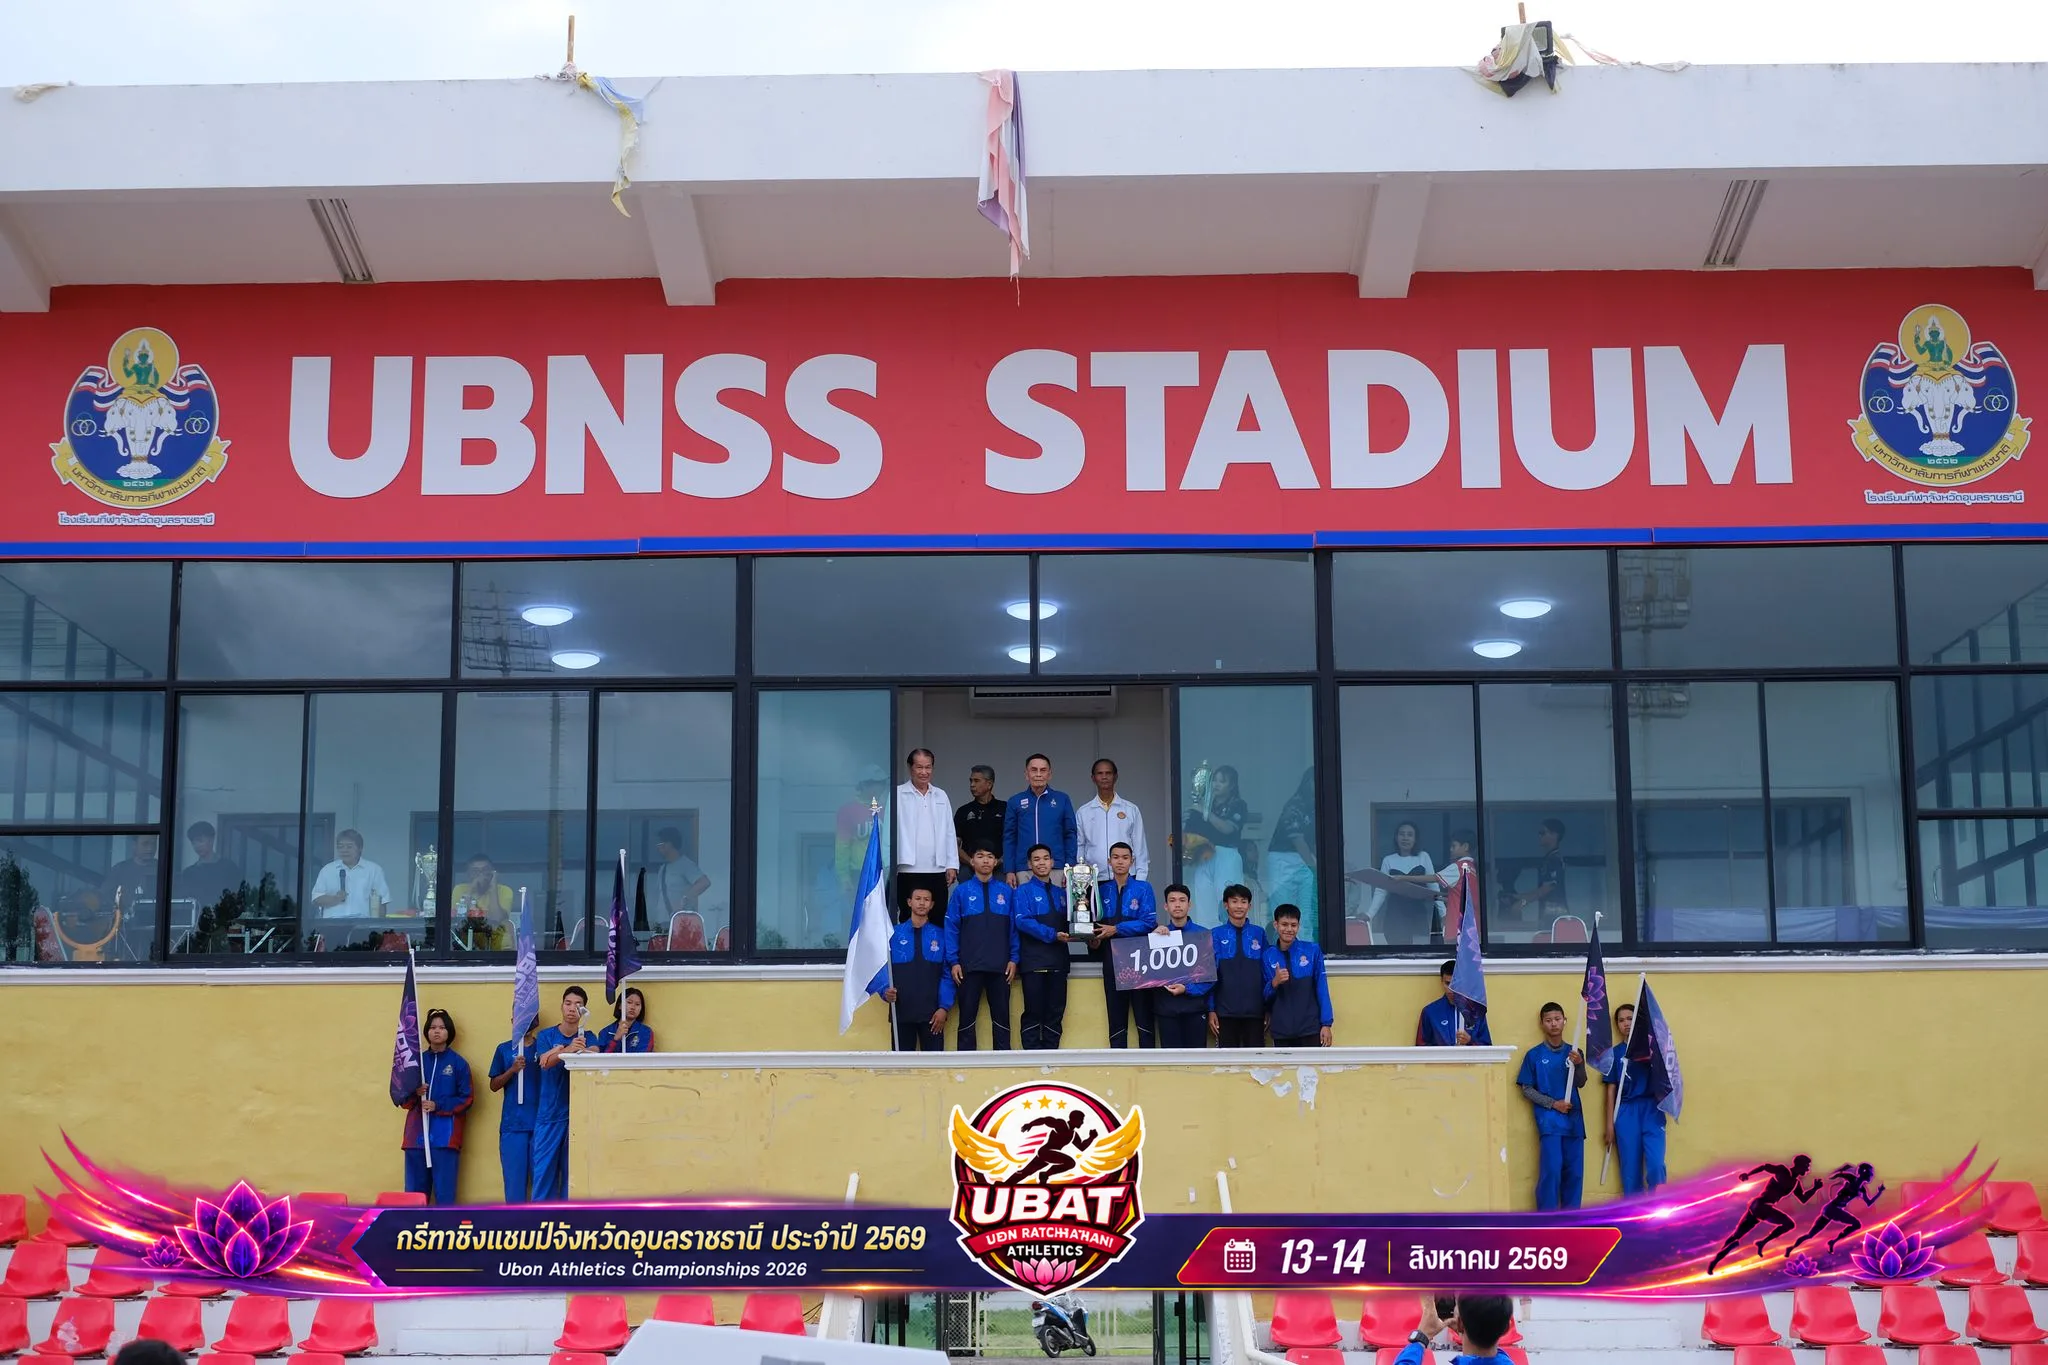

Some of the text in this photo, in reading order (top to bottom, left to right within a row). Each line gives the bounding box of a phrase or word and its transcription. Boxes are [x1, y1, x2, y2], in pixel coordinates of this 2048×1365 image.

[289, 345, 1793, 498] UBNSS STADIUM
[1130, 943, 1198, 974] 1,000
